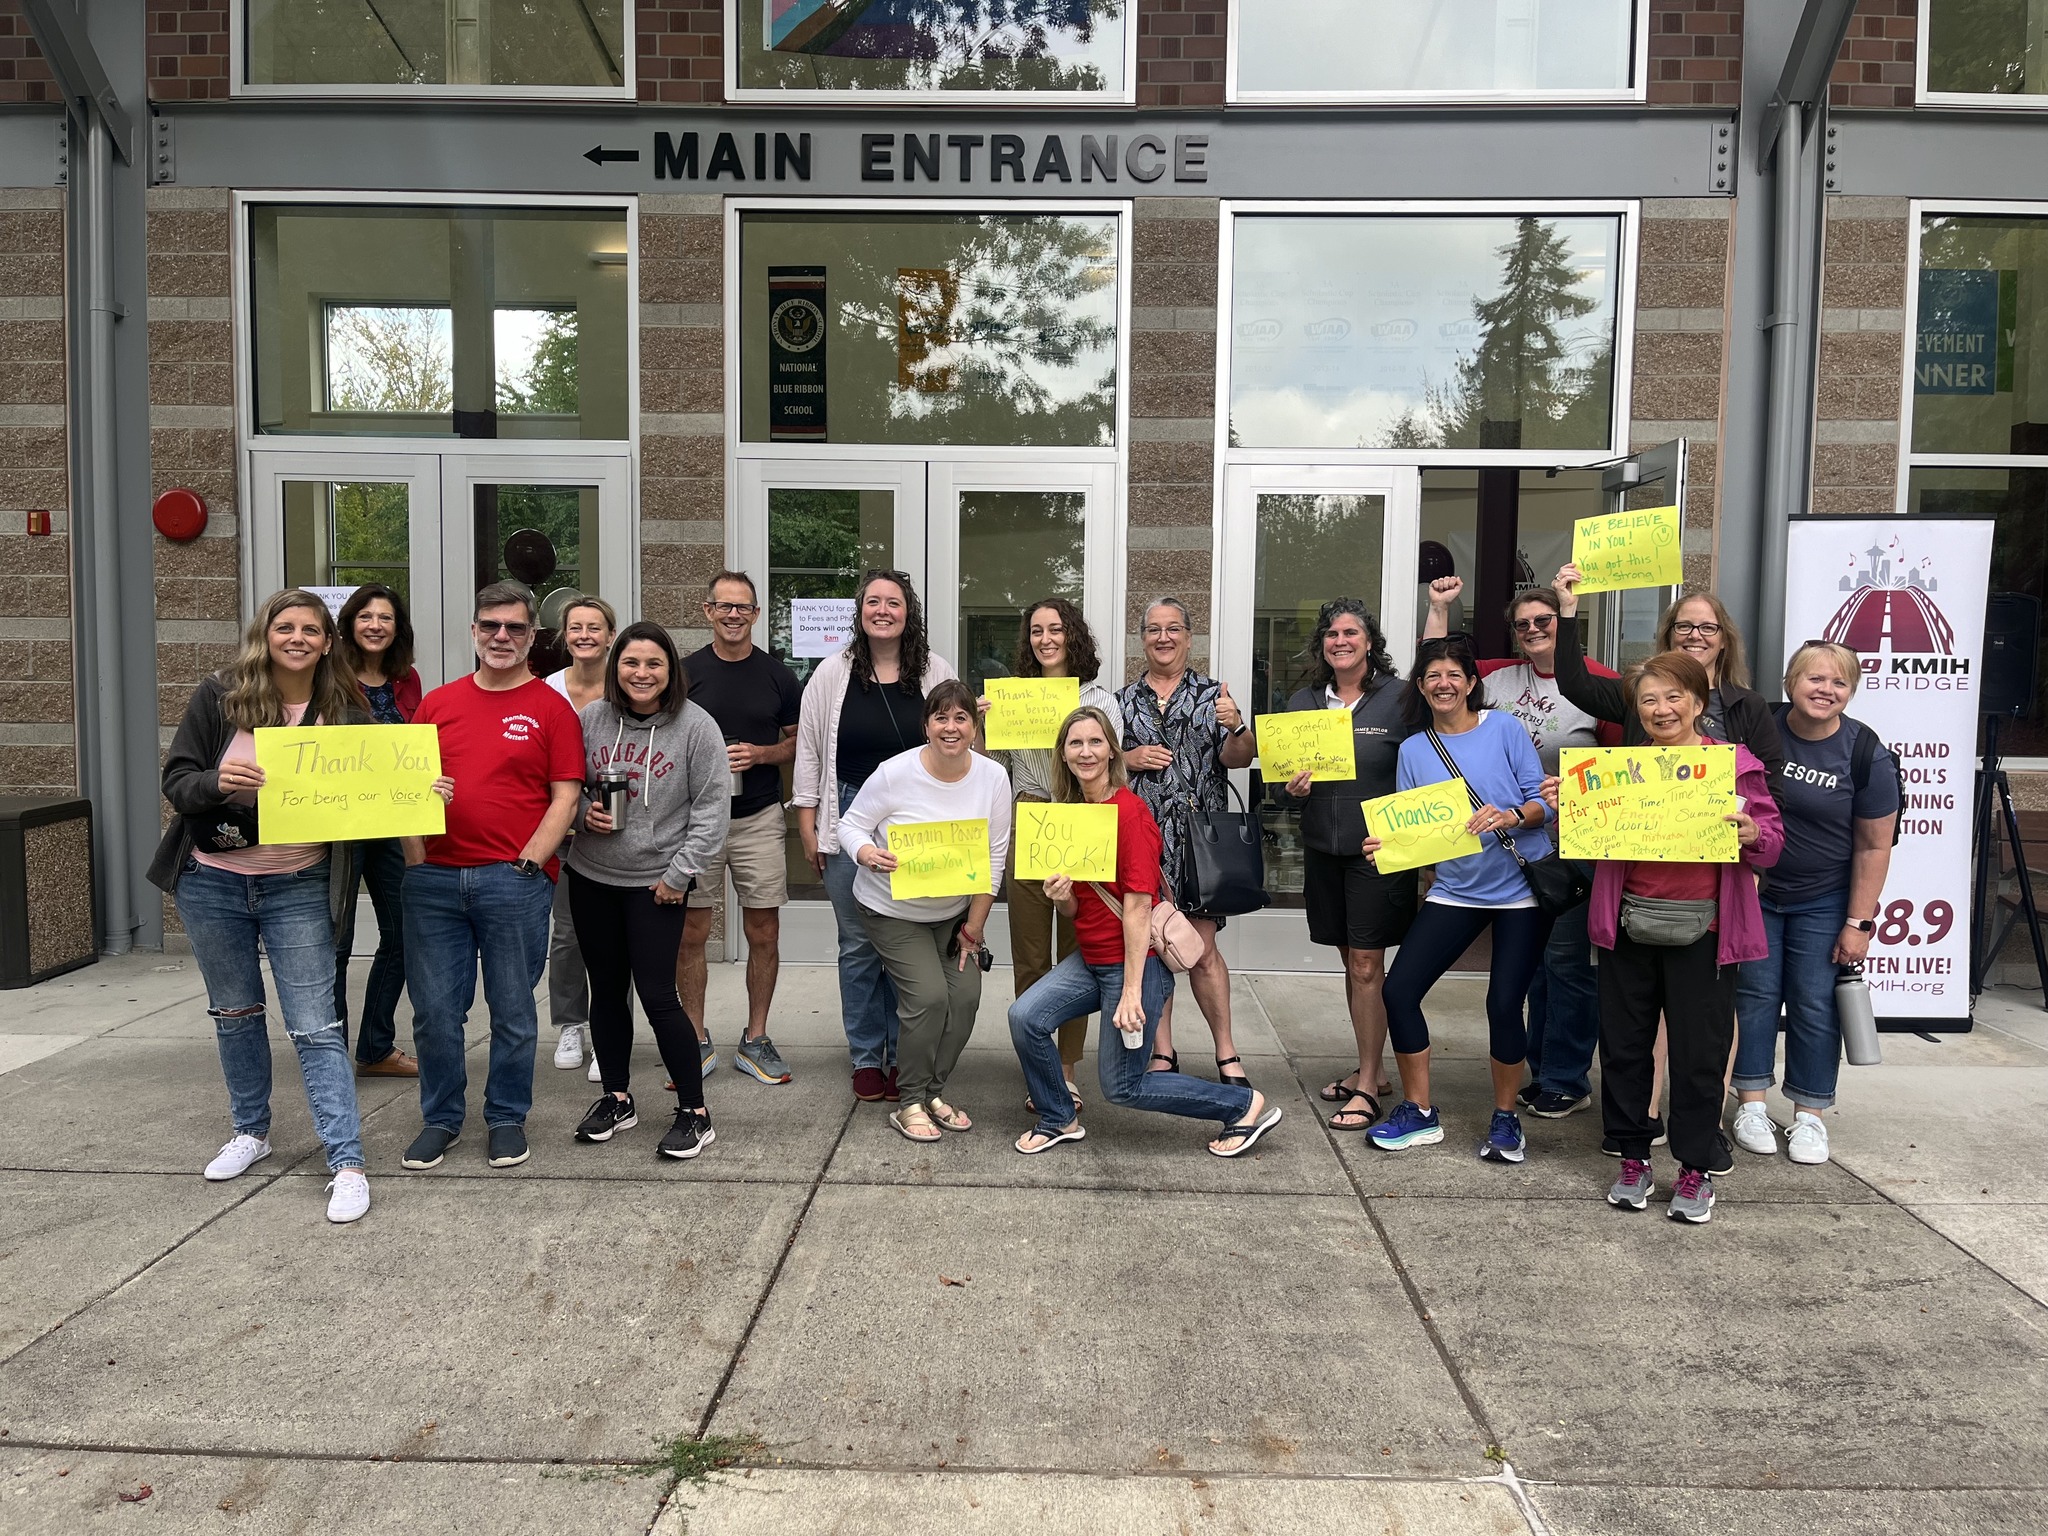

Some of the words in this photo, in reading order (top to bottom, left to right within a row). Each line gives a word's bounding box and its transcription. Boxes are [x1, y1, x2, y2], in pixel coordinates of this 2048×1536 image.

[654, 131, 811, 180] MAIN
[861, 133, 1209, 182] ENTRANCE
[1378, 324, 1412, 336] WIAA
[779, 363, 818, 373] NATIONAL
[773, 384, 793, 394] BLUE
[794, 384, 824, 394] RIBBON
[784, 405, 814, 415] SCHOOL
[1581, 521, 1600, 537] WE
[1608, 514, 1663, 531] BELIEVE
[1589, 538, 1600, 551] IN
[1579, 555, 1599, 572] You
[1606, 555, 1623, 577] got
[331, 592, 347, 600] YOU
[1891, 658, 1970, 675] KMIH
[1866, 676, 1970, 691] BRIDGE
[993, 688, 1034, 701] Thank
[1040, 686, 1060, 701] You
[1000, 704, 1016, 718] for
[1025, 703, 1056, 718] being
[502, 713, 540, 729] Membership
[508, 723, 529, 733] MIEA
[1006, 719, 1024, 728] our
[1265, 718, 1283, 737] So
[1291, 718, 1332, 741] grateful
[502, 730, 529, 741] Matters
[1277, 738, 1293, 751] for
[1888, 742, 1950, 759] ISLAND
[283, 739, 374, 775] Thank
[391, 741, 431, 772] You
[591, 742, 675, 779] COUGARS
[1314, 751, 1326, 761] for
[1329, 755, 1348, 765] your
[1568, 757, 1646, 796] Thank
[1654, 753, 1707, 782] You
[1782, 761, 1838, 789] ESOTA
[281, 790, 309, 807] For
[313, 788, 348, 811] being
[357, 792, 381, 801] our
[1376, 800, 1454, 832] Thanks
[1565, 800, 1590, 824] for
[1900, 819, 1943, 835] TION
[890, 828, 943, 856] Bargain
[1029, 839, 1110, 874] ROCK!
[900, 856, 942, 876] Thank
[1906, 957, 1952, 975] LIVE!
